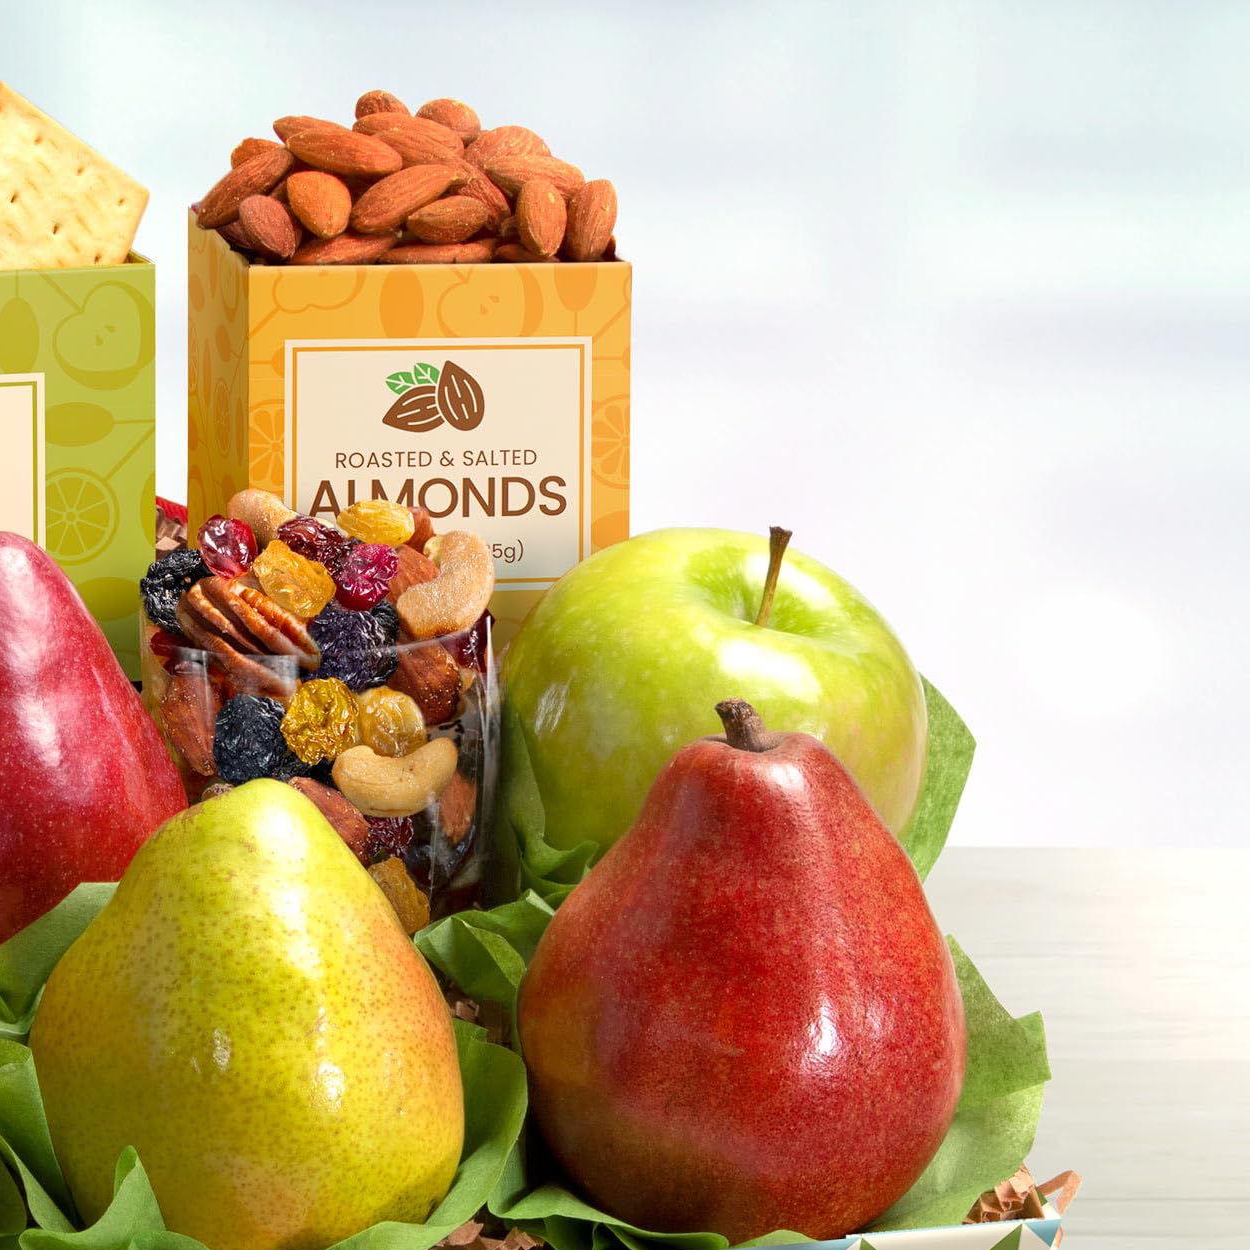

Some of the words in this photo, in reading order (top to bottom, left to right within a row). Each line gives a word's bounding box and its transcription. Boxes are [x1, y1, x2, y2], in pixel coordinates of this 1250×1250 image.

[335, 452, 432, 469] ROASTED
[439, 451, 455, 468] &
[463, 449, 537, 467] SALTED
[487, 539, 524, 563] 5g)
